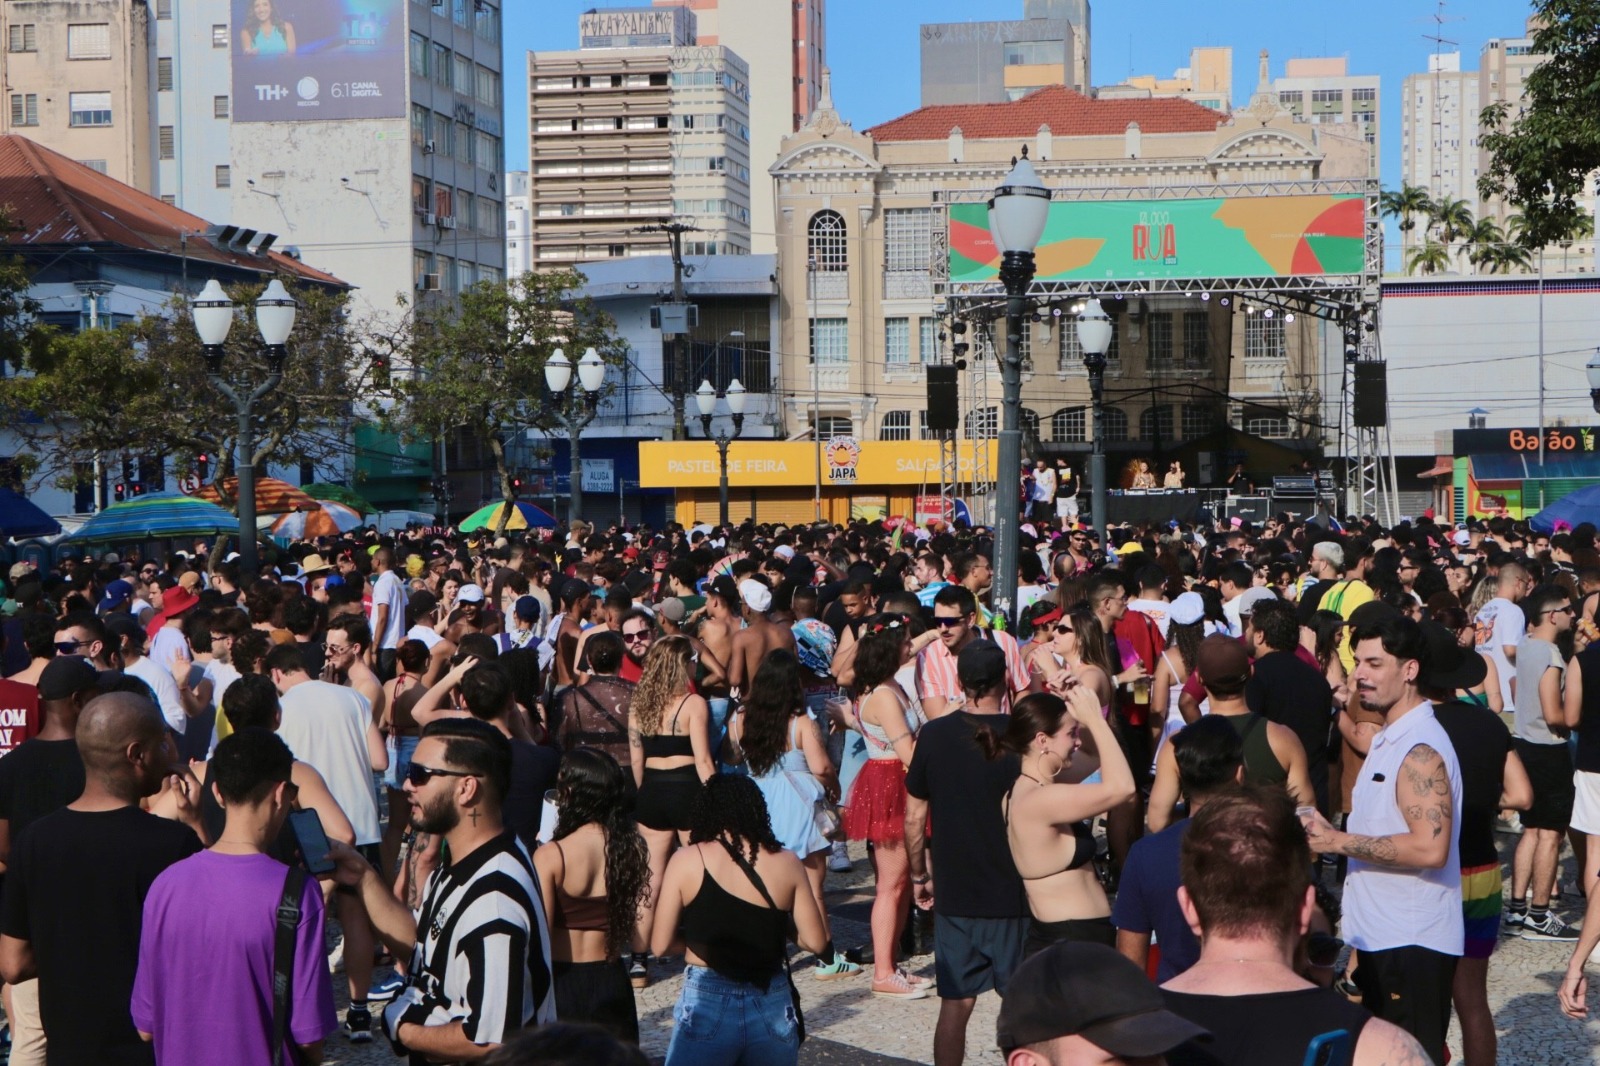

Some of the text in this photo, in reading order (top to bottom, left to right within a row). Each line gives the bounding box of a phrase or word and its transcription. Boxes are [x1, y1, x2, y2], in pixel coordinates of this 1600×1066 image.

[255, 85, 289, 101] TH+
[331, 82, 379, 98] 6.1 CANAL
[351, 89, 382, 97] DIGITAL
[1132, 224, 1176, 260] RUA
[668, 459, 719, 473] PASTEL
[746, 459, 787, 472] FEIRA
[829, 467, 856, 479] JAPA
[590, 471, 610, 480] ALUGA
